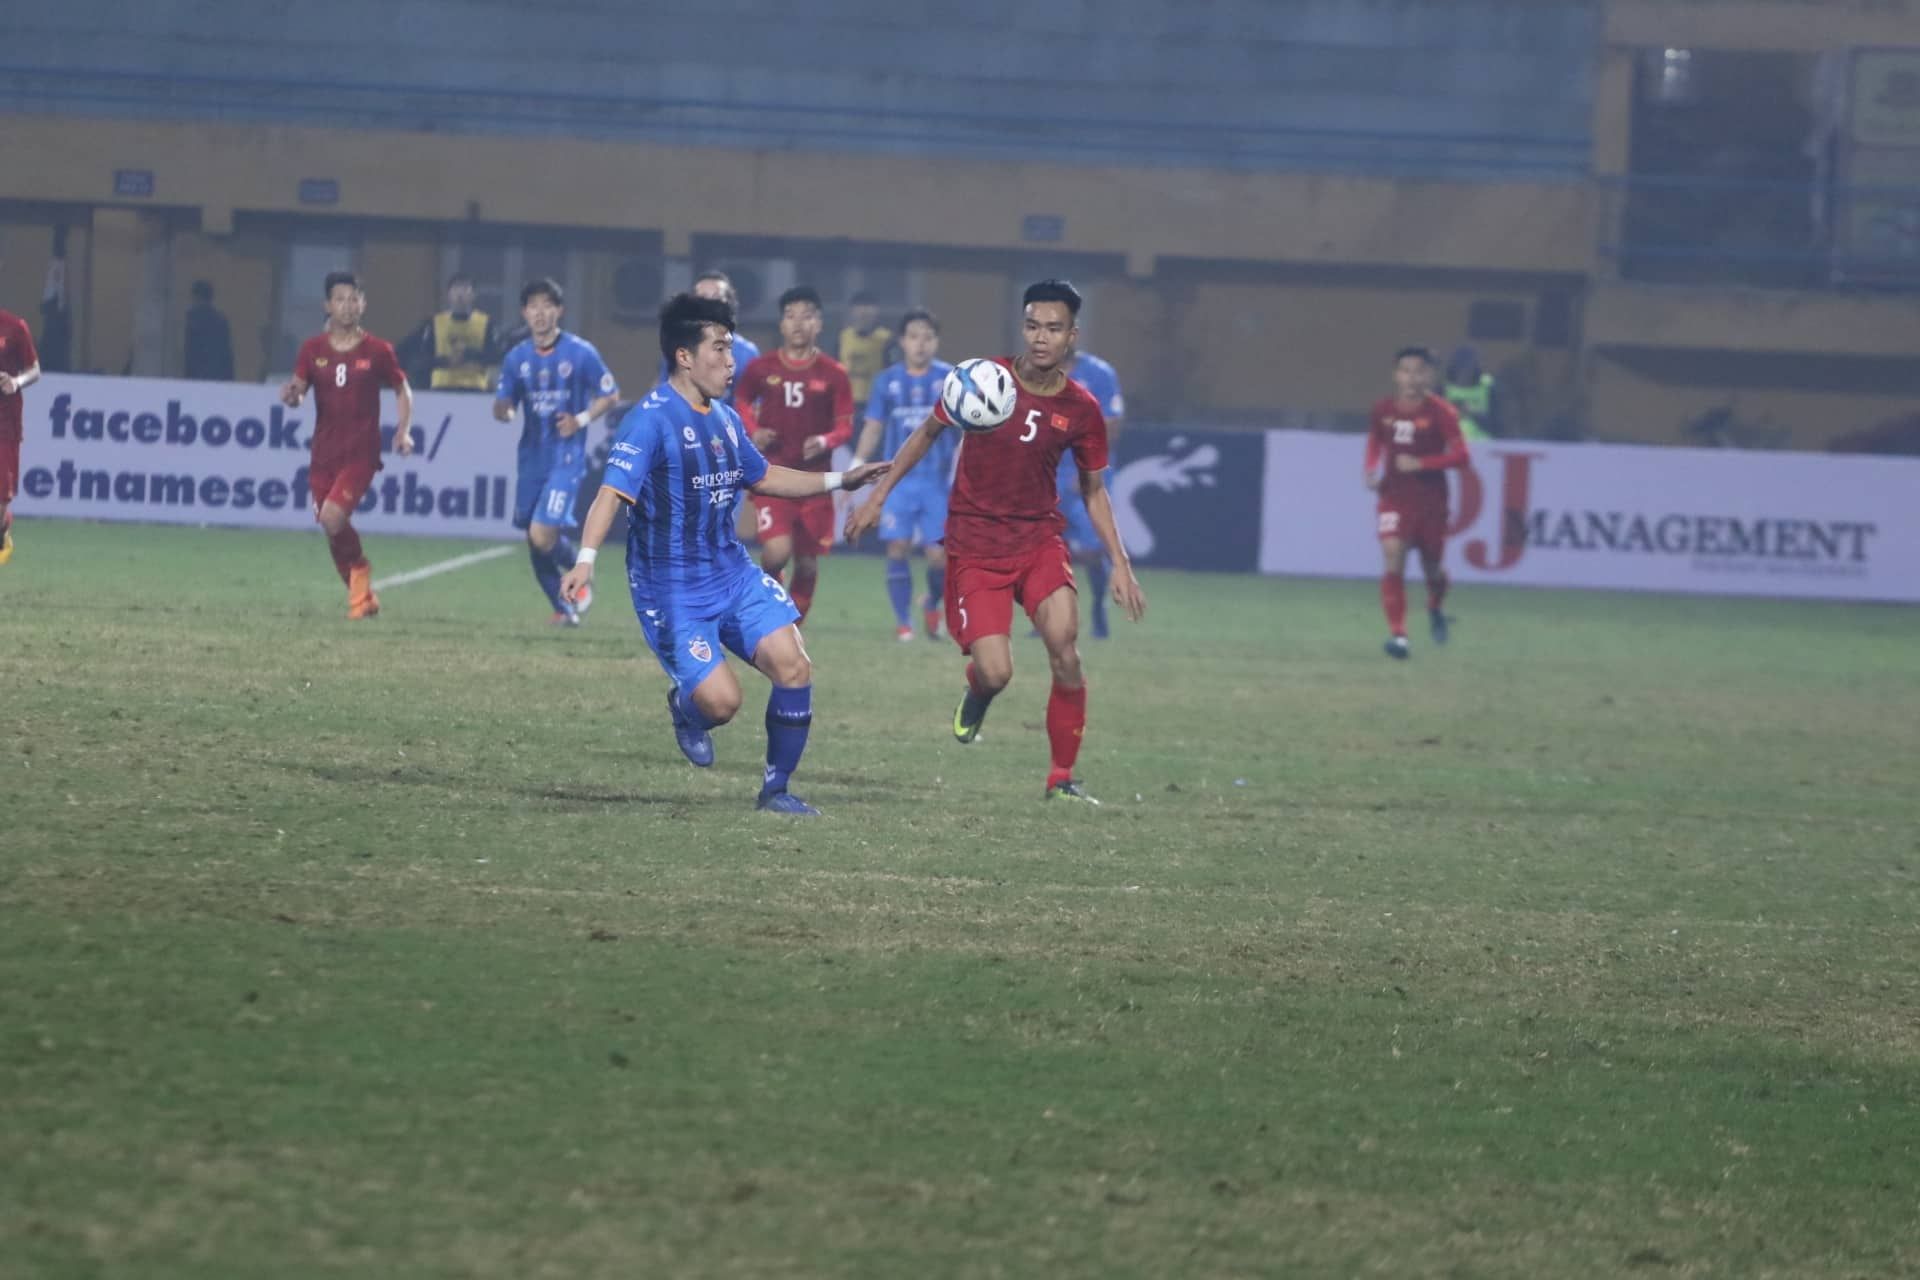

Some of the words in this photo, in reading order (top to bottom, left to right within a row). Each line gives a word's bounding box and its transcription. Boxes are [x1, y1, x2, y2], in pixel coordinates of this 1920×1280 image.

[335, 363, 347, 387] 8
[783, 381, 805, 408] 15
[49, 393, 452, 462] facebook.m/
[1019, 410, 1042, 442] 5
[546, 489, 567, 515] 16
[1505, 507, 1878, 563] MANAGEMENT
